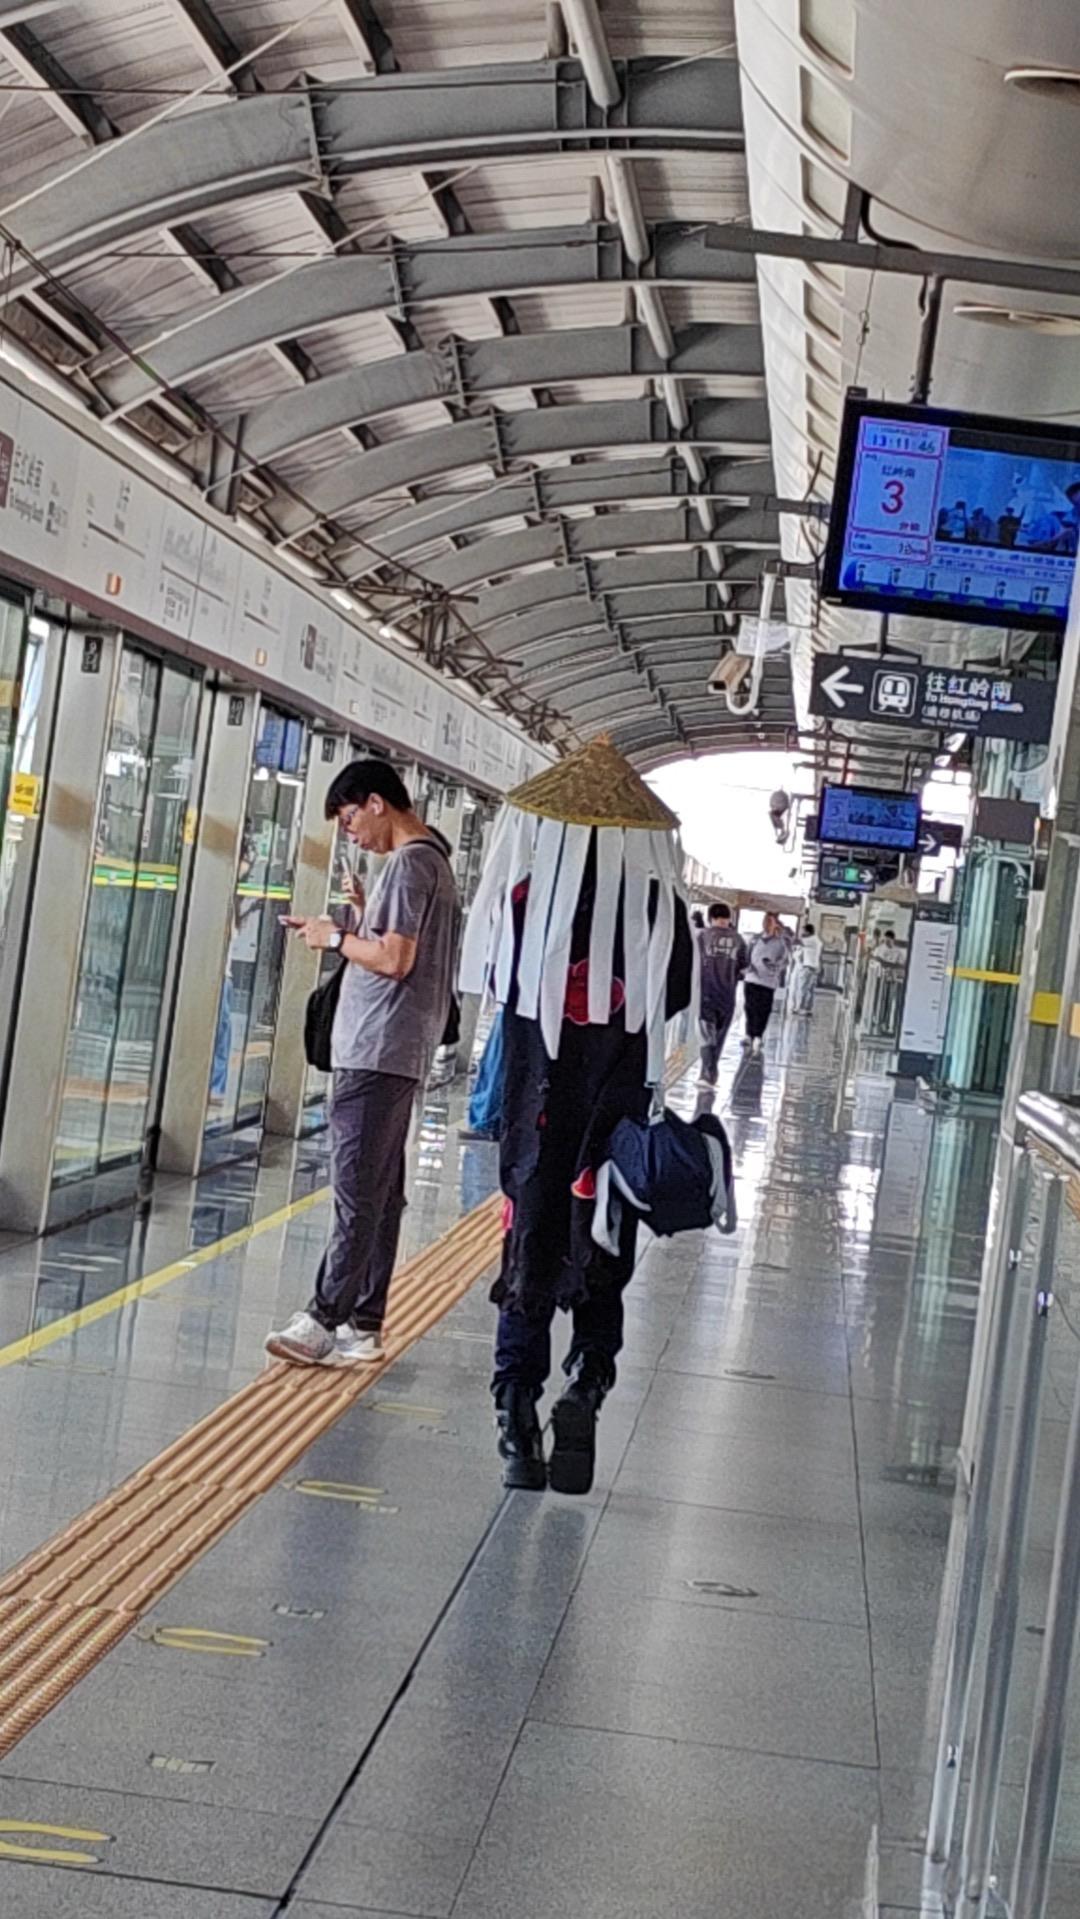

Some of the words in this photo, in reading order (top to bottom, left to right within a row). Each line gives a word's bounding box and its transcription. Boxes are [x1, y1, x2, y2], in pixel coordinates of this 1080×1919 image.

[880, 480, 905, 515] 3
[926, 672, 1013, 702] 往红岭南
